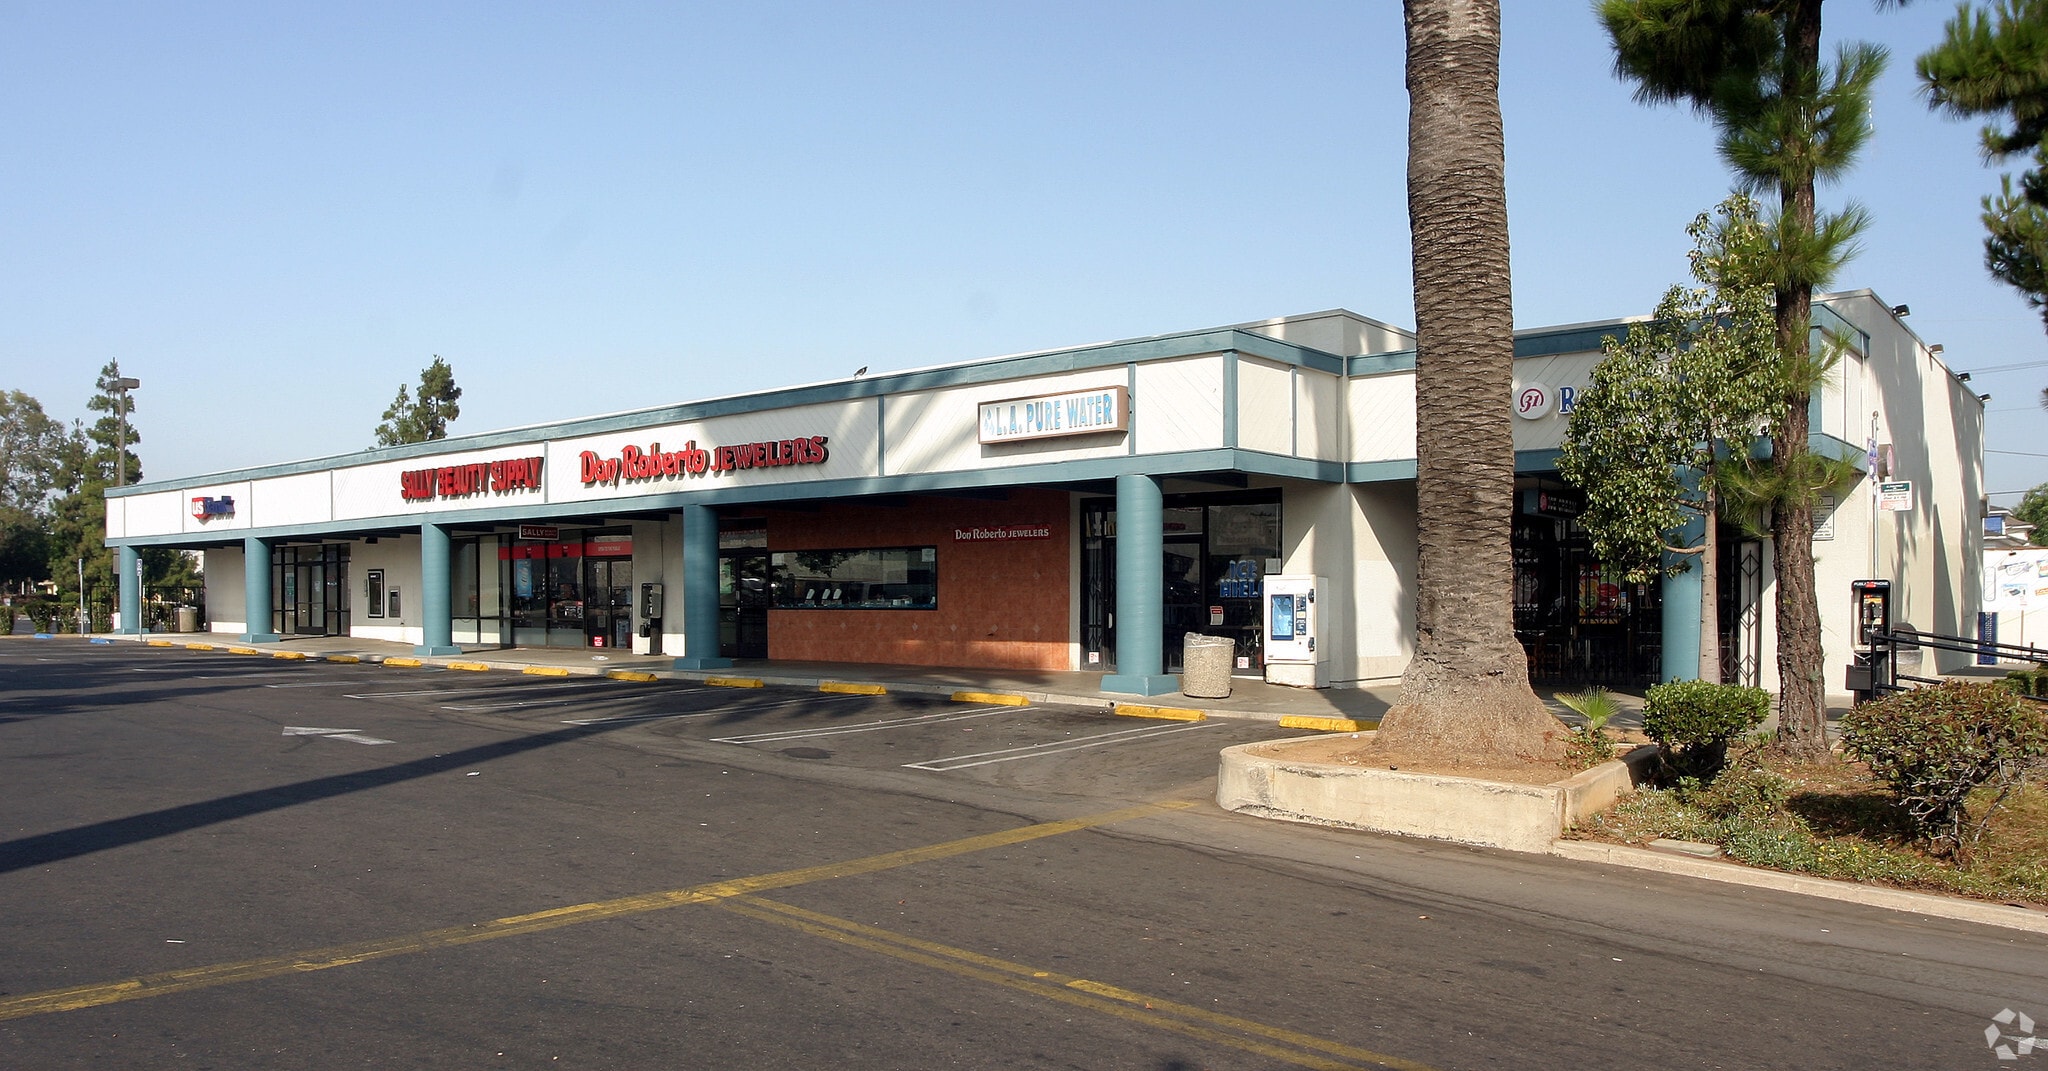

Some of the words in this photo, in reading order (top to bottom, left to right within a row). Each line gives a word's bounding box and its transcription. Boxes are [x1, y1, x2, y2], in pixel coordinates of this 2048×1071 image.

[1519, 390, 1542, 412] 31
[996, 405, 1022, 435] L.A.
[1026, 400, 1061, 431] PURE
[1066, 394, 1112, 428] WATER
[579, 450, 619, 486] Don
[621, 440, 708, 479] Roberto
[710, 436, 828, 472] JEWELERS
[401, 468, 436, 499] SALLY
[437, 463, 491, 495] BEAUTY
[491, 457, 544, 491] SUPPLY
[522, 528, 544, 537] SALLY
[955, 529, 971, 540] Don
[973, 528, 1007, 539] Roberto
[1008, 528, 1049, 538] JEWELERS
[1229, 559, 1257, 579] ICE
